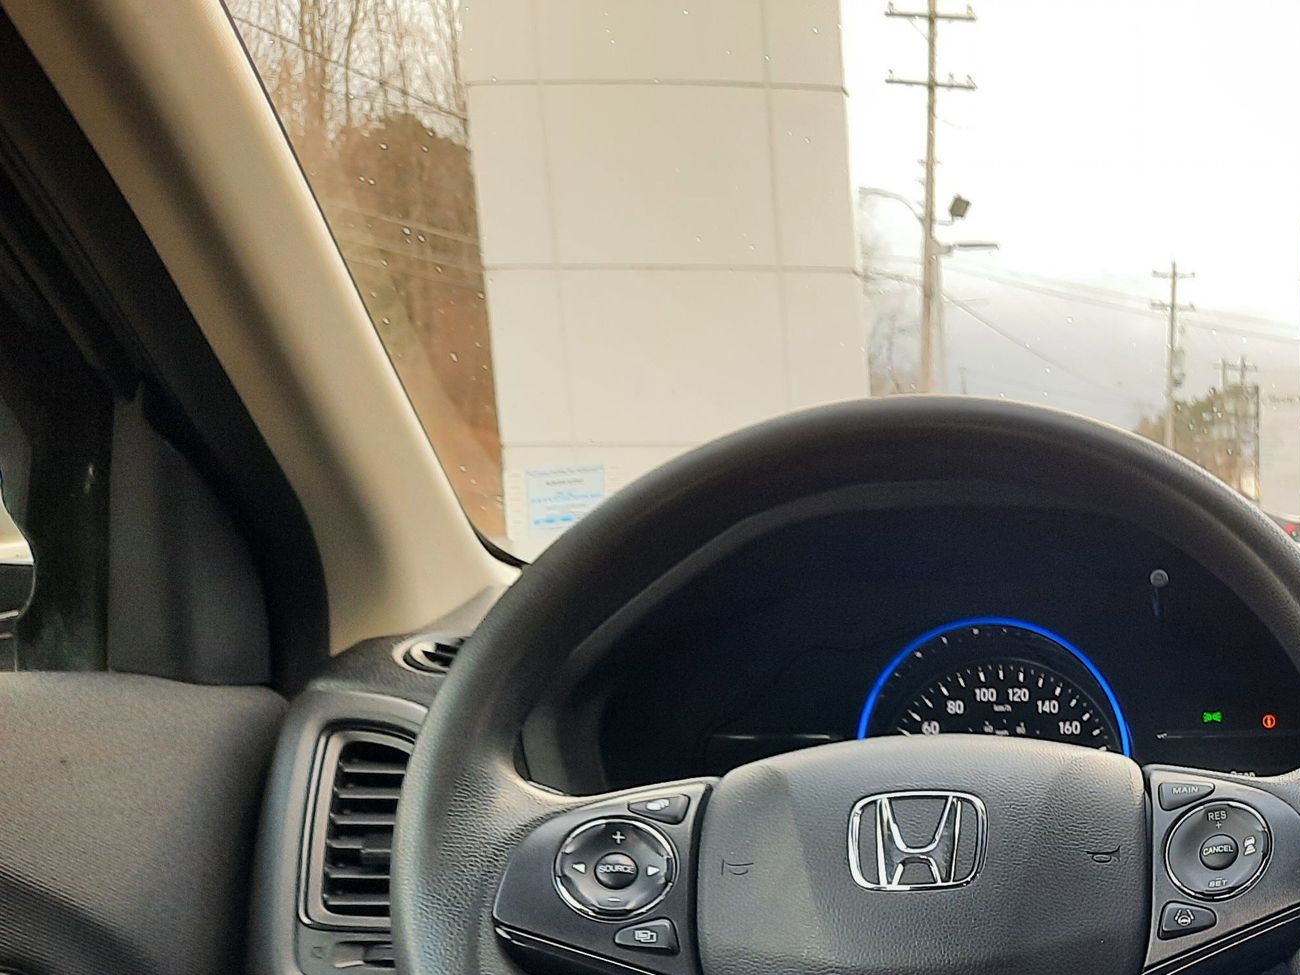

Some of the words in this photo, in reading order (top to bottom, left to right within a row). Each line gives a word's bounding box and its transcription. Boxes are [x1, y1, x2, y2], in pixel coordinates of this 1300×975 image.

[975, 688, 997, 702] 100
[1008, 688, 1030, 702] 120
[947, 700, 964, 714] 80
[1037, 700, 1059, 714] 140
[922, 721, 941, 735] 60
[1058, 721, 1081, 735] 160
[1172, 786, 1199, 794] MAIN
[1207, 810, 1227, 821] RES
[1202, 844, 1235, 856] CANCEL
[598, 864, 635, 874] SOURCE
